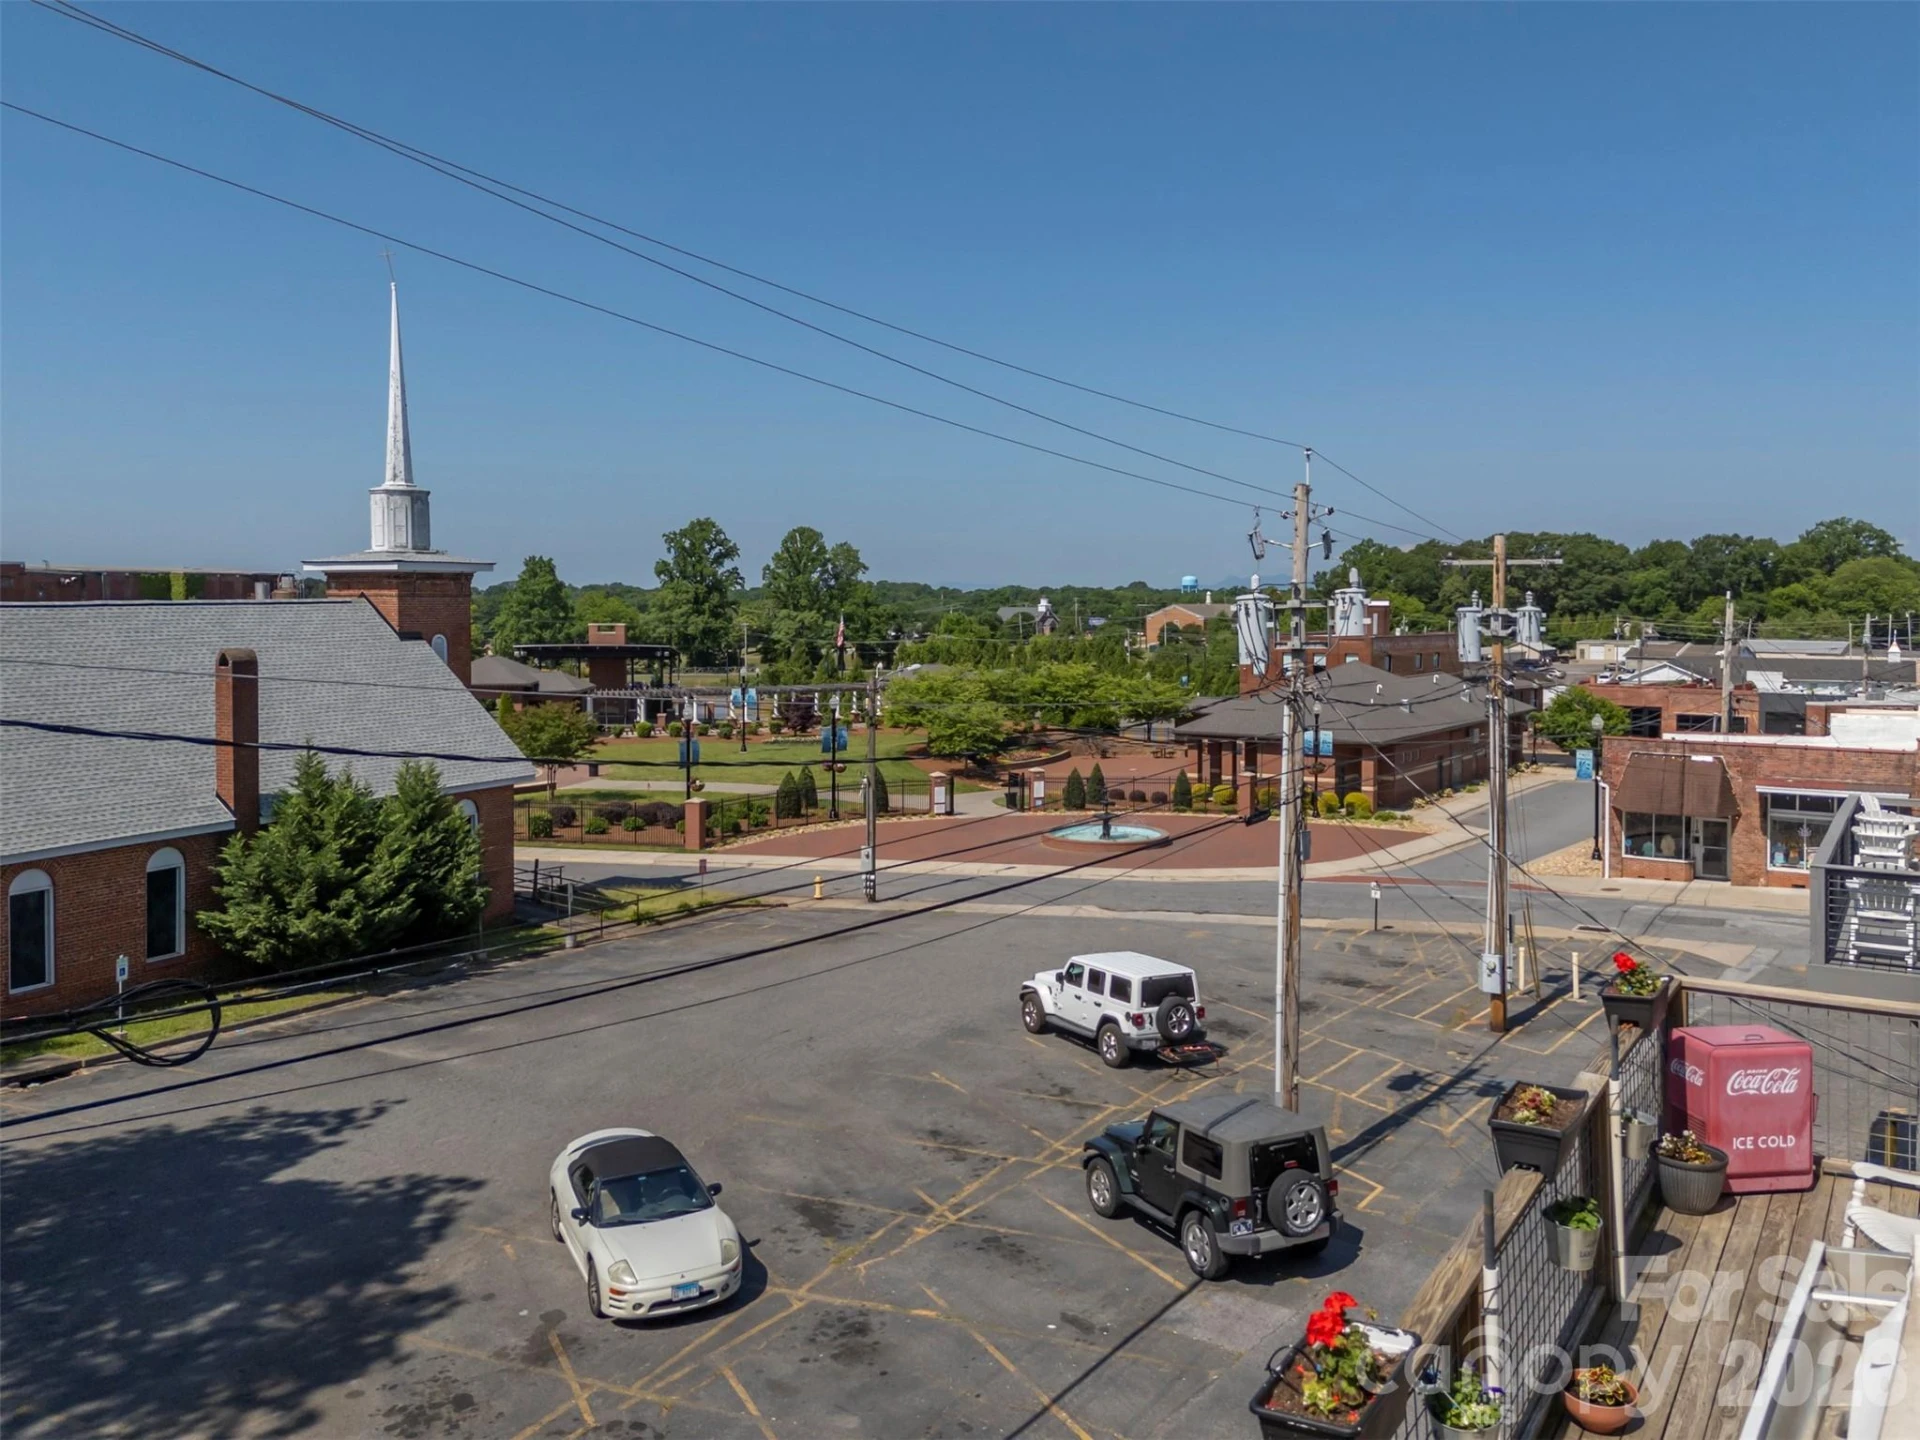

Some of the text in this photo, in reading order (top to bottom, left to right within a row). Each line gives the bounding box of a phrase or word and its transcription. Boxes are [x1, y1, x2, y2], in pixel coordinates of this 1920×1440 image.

[1726, 1067, 1801, 1096] Coca-Cola
[1732, 1135, 1796, 1149] ICE COLD
